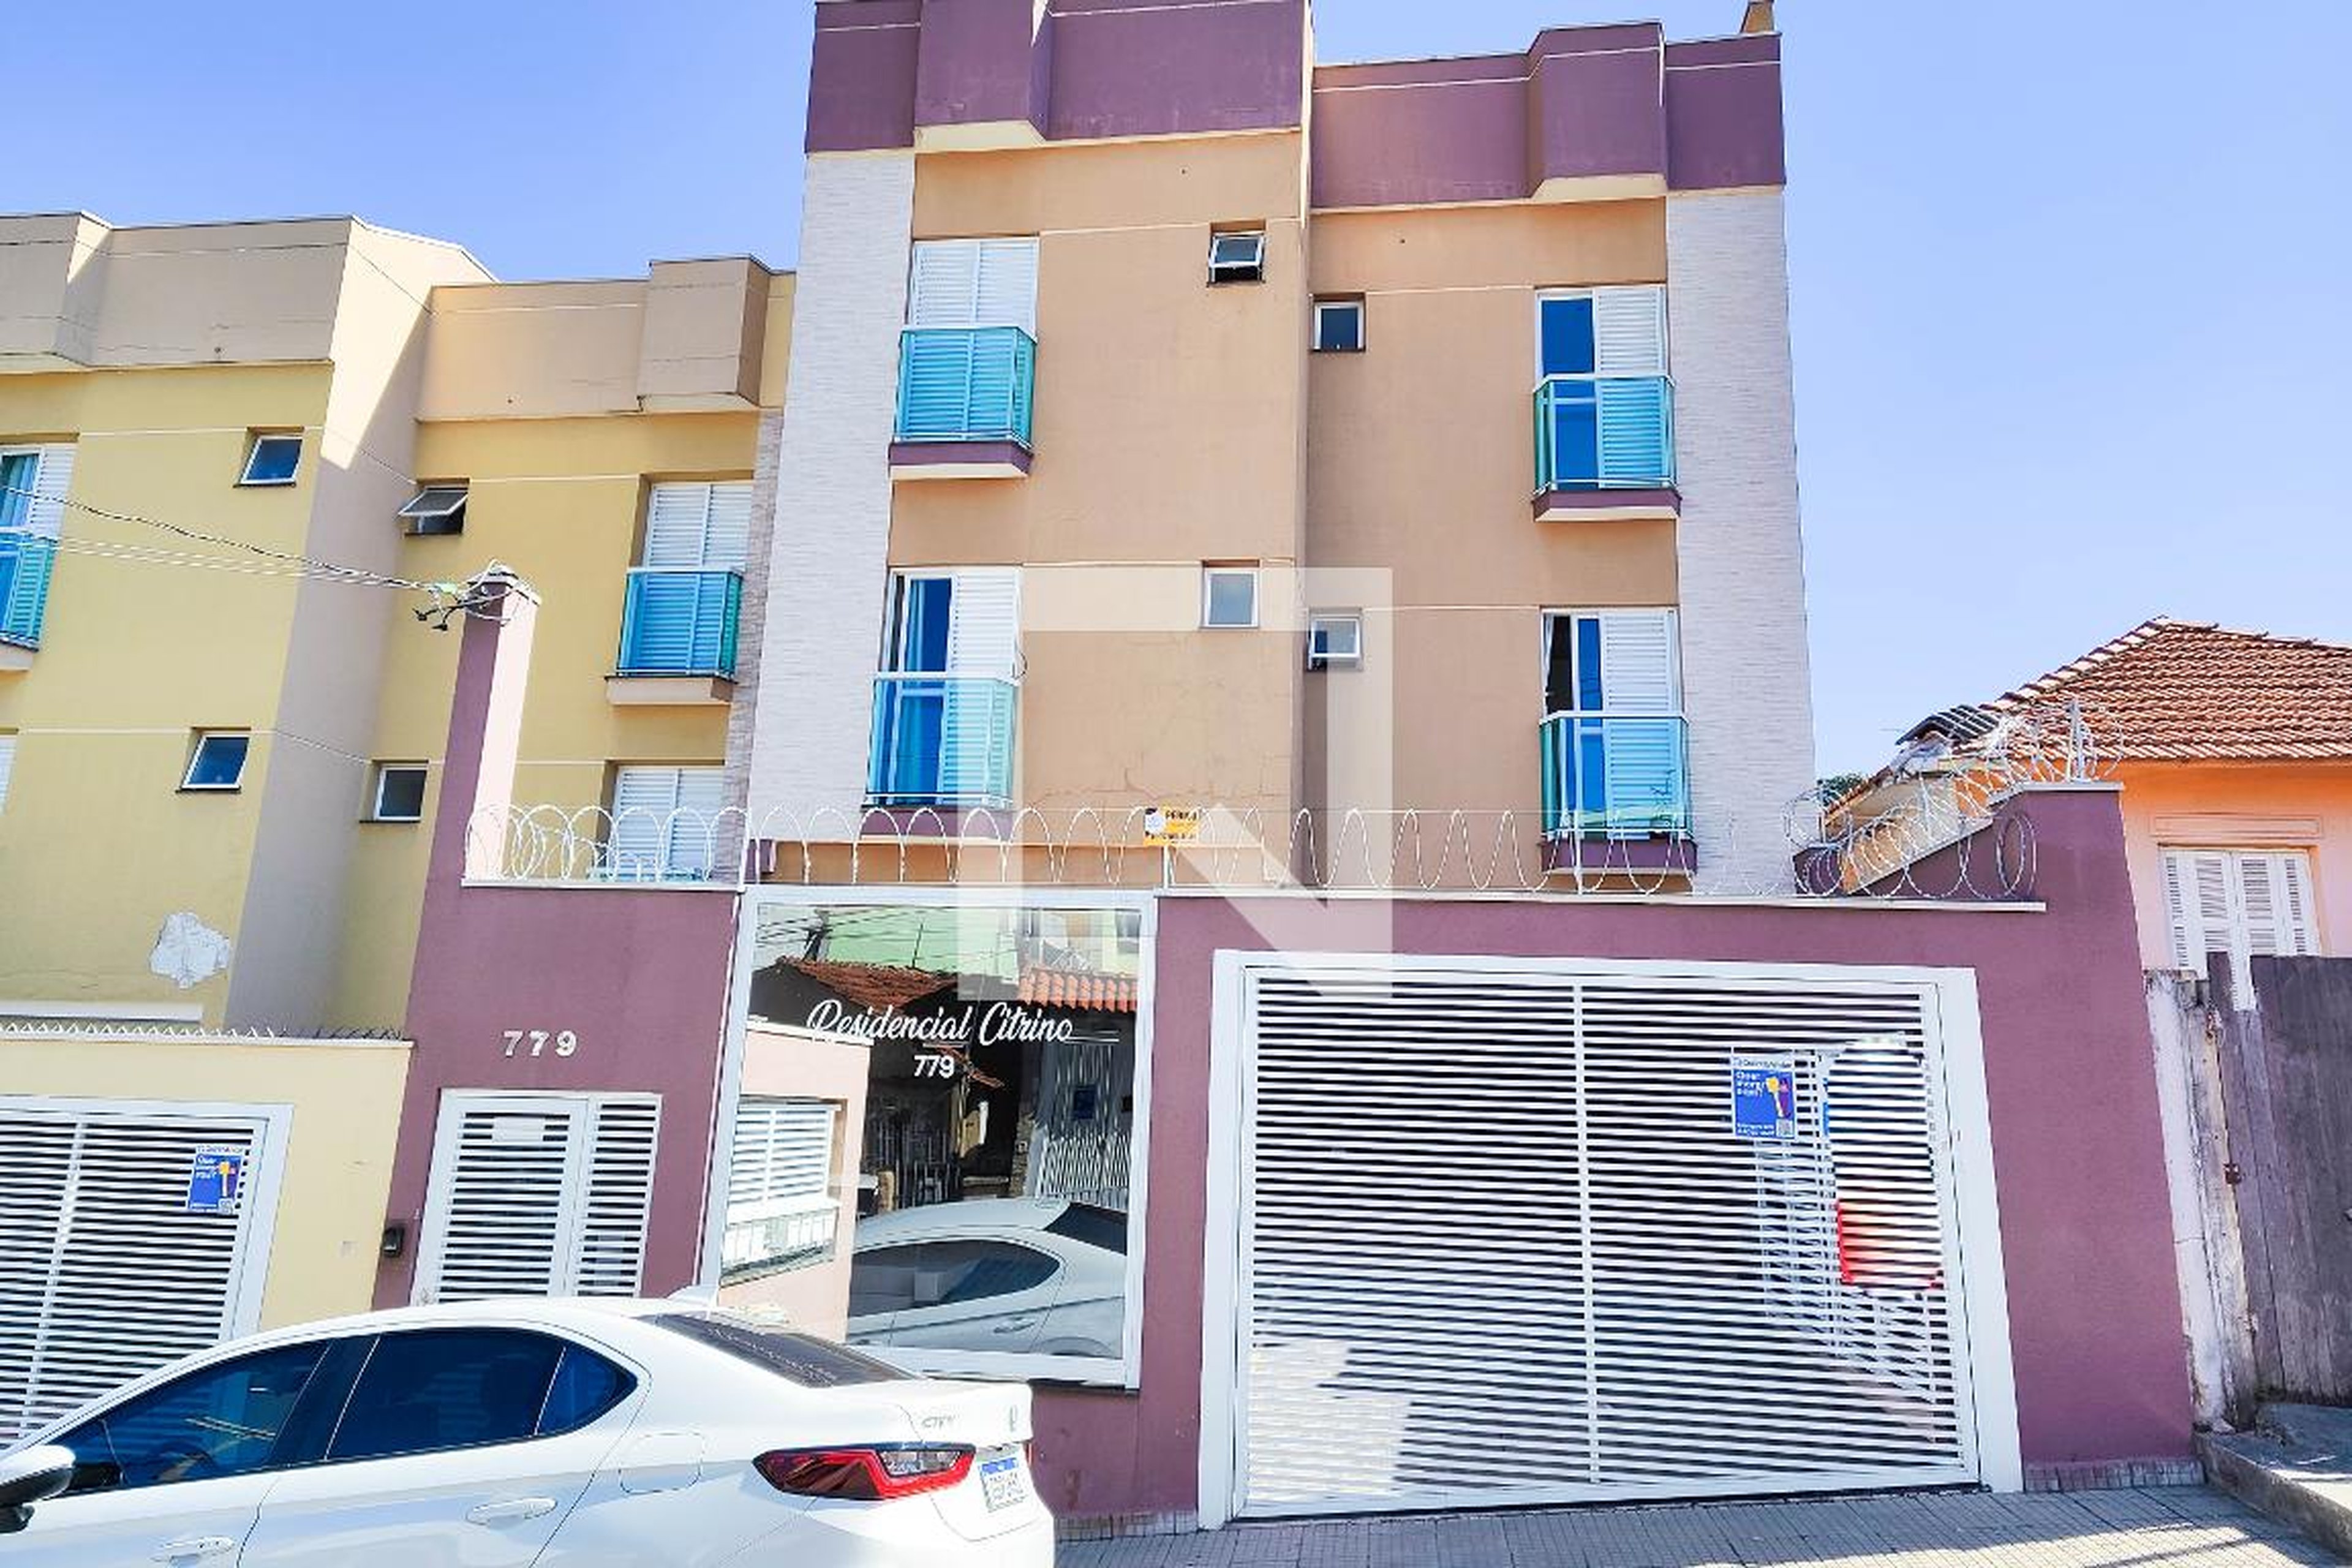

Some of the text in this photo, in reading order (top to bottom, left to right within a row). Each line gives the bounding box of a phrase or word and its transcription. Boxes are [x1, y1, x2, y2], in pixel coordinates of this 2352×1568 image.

[807, 999, 1076, 1047] Residencial Citrino
[502, 1030, 578, 1057] 779
[913, 1054, 956, 1077] 779
